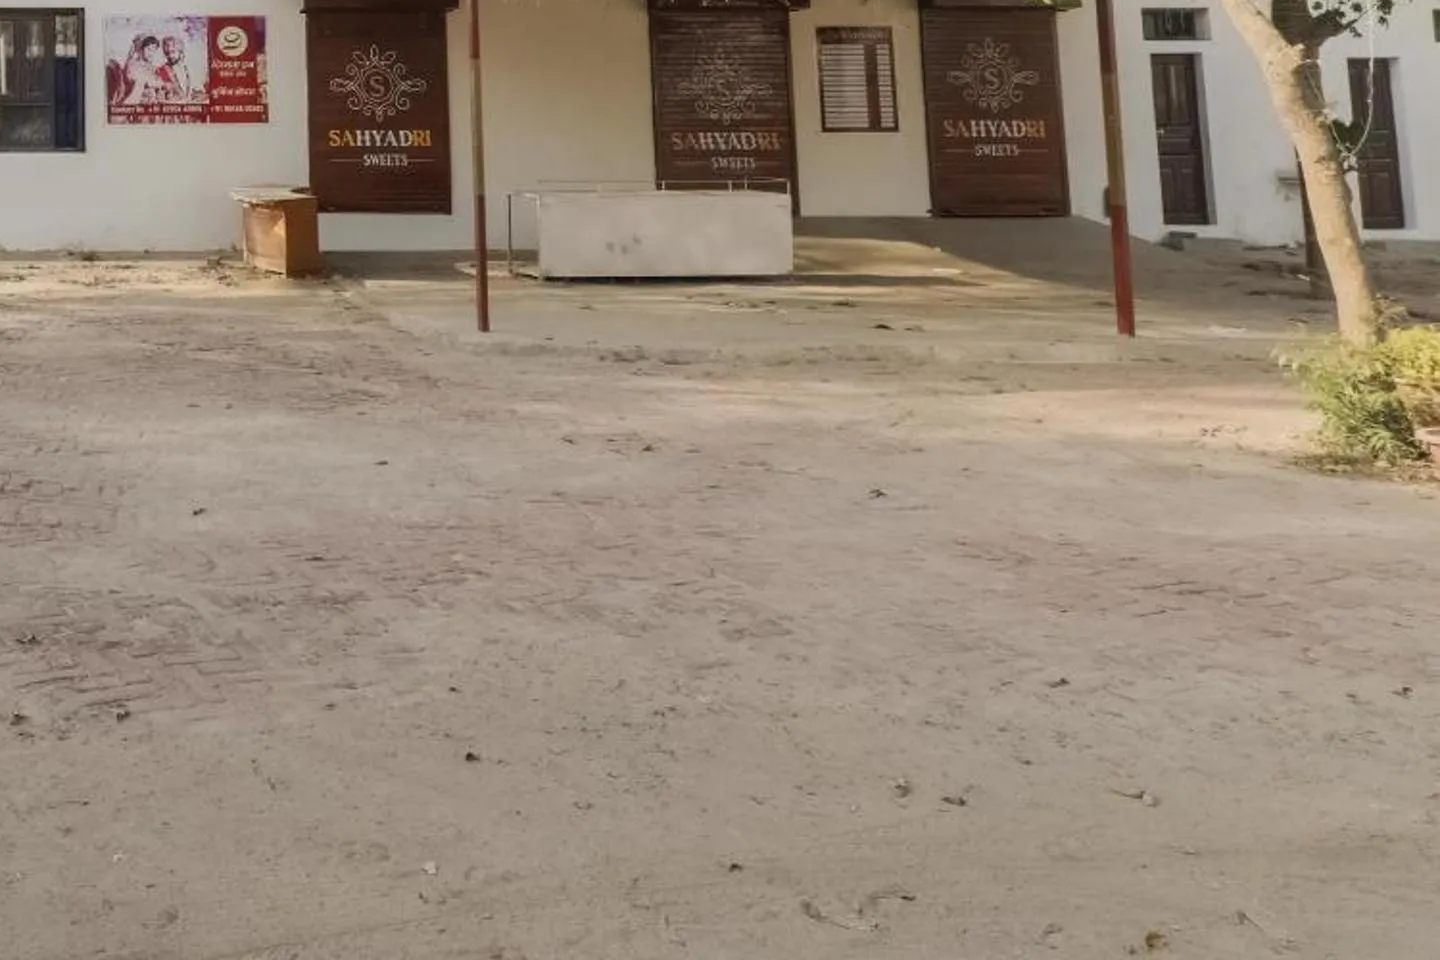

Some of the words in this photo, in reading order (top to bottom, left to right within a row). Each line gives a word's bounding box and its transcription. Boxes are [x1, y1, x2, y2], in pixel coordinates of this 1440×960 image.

[942, 119, 1047, 138] SAHYADRI
[328, 130, 433, 147] SAHYADRI
[671, 131, 781, 150] SAHYADRI
[974, 144, 1020, 157] SWEETS
[363, 154, 408, 167] SWEETS
[710, 156, 756, 169] SWEETS
